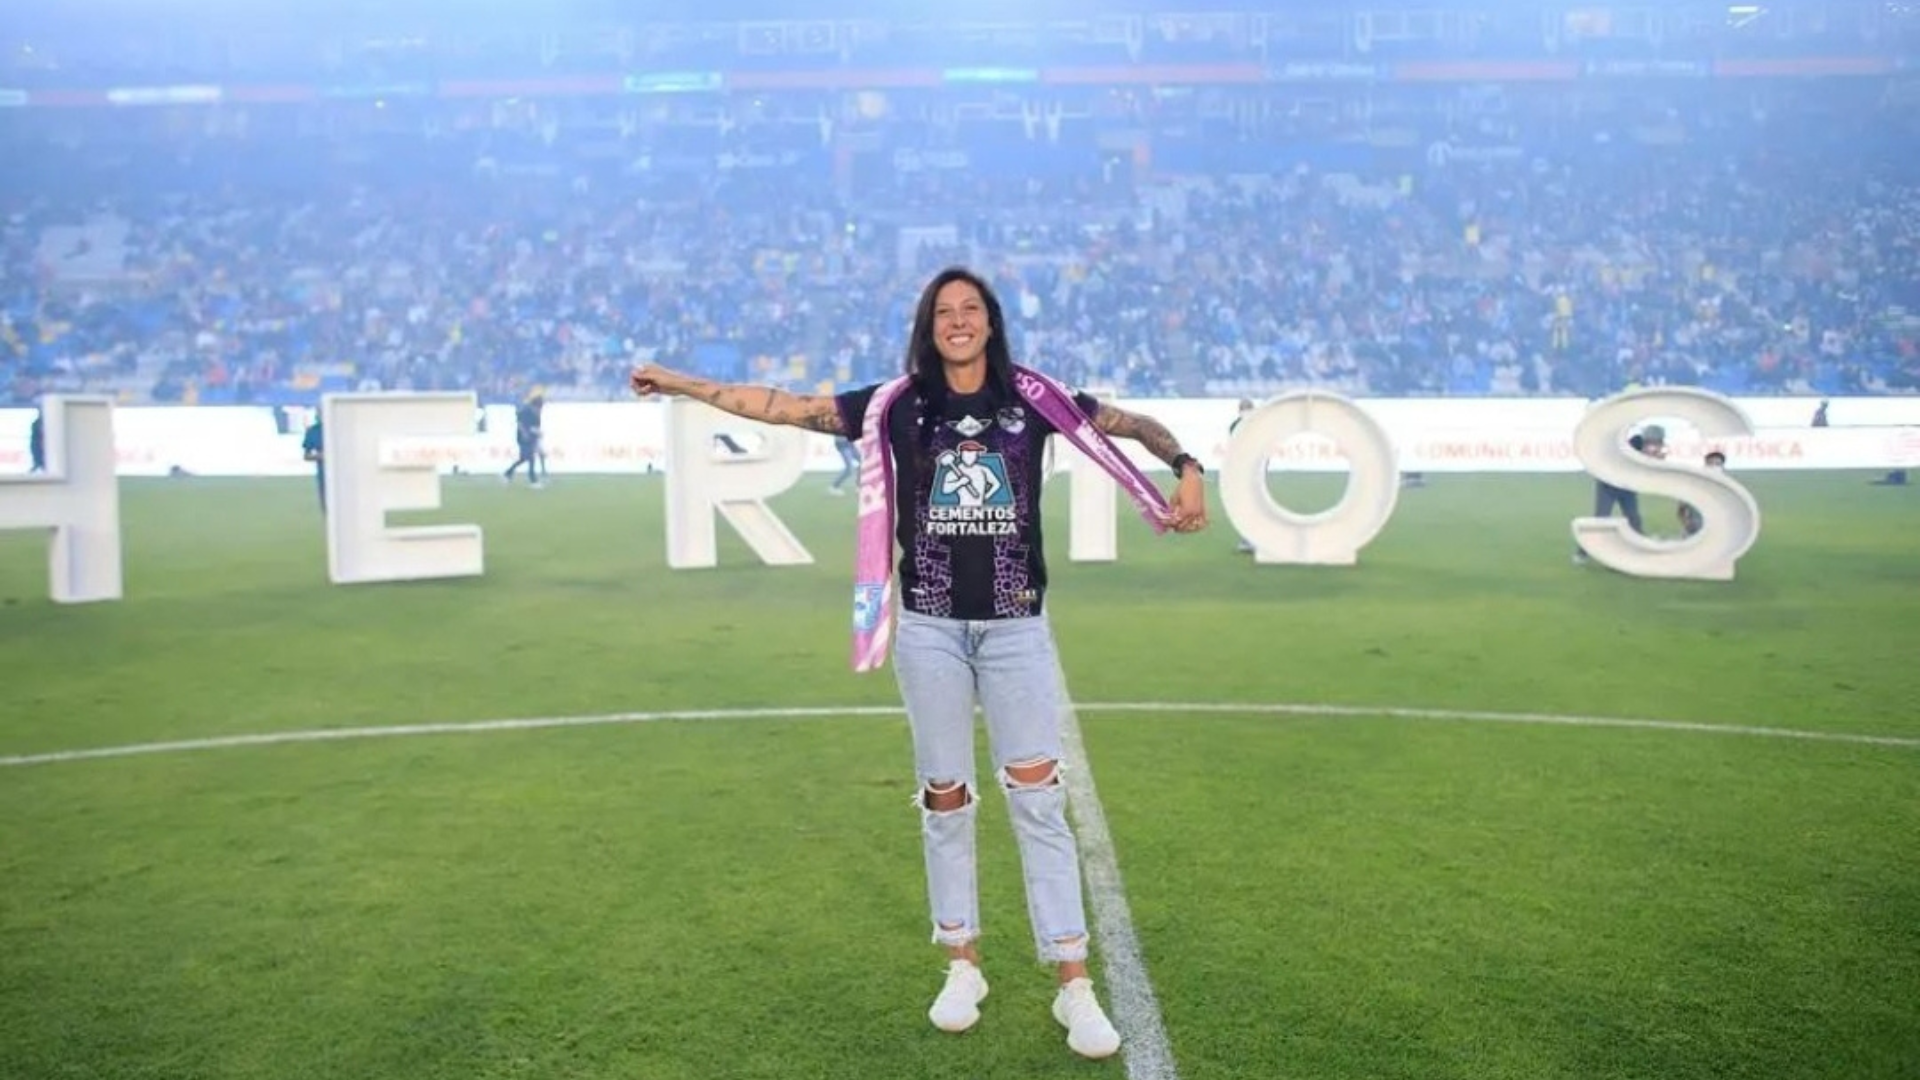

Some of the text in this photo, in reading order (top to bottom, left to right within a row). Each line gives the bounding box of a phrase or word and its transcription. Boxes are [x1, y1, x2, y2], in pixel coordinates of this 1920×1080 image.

[1413, 440, 1576, 459] COMUNICACIÓ
[929, 507, 1016, 521] CEMENTOS
[927, 521, 1018, 536] FORTALEZA
